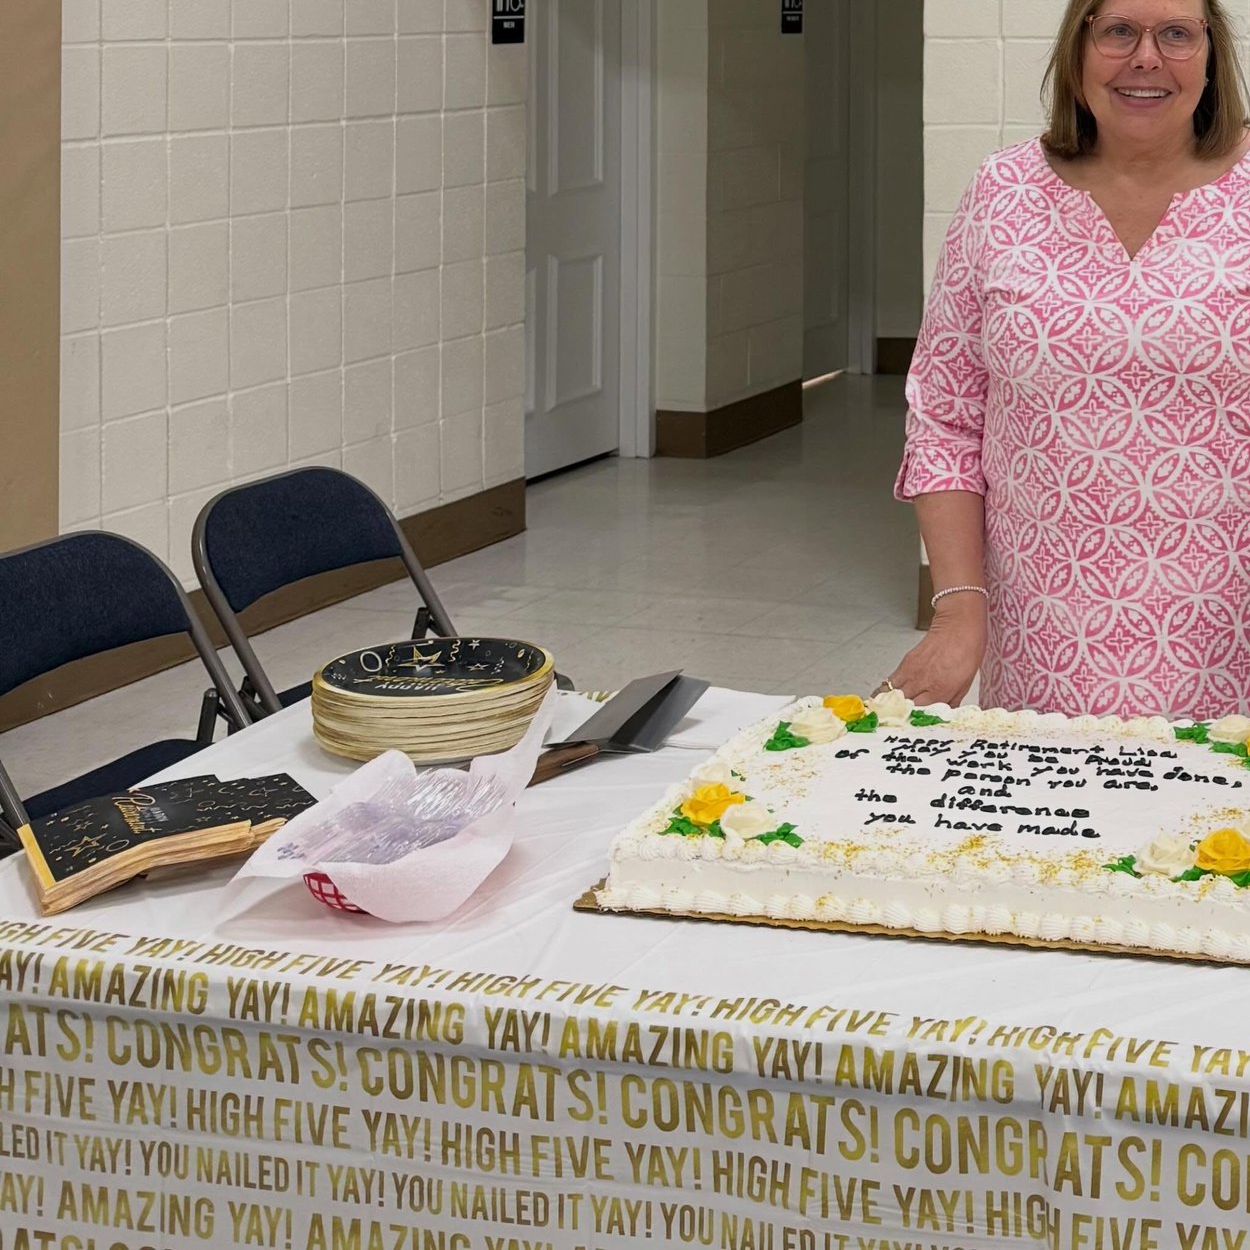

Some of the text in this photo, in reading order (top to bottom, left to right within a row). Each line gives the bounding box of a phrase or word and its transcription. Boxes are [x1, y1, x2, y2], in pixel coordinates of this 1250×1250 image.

[946, 758, 1012, 771] work
[1096, 766, 1154, 778] have
[970, 738, 1105, 755] Retirement
[1119, 746, 1177, 758] Lisa
[854, 788, 897, 803] the
[863, 812, 1101, 839] you have made
[957, 784, 1012, 798] and
[0, 949, 45, 993] AY!
[49, 957, 210, 1012] AMAZING
[226, 977, 291, 1020] YAY!
[299, 987, 466, 1043] AMAZING
[484, 1008, 550, 1051] YAY!
[558, 1017, 735, 1072] AMAZING
[752, 1036, 823, 1084] YAY!
[834, 1044, 1015, 1102] AMAZING
[1034, 1065, 1103, 1117] YAY!
[36, 927, 131, 953] FIVE
[123, 936, 204, 962] YAY!
[197, 941, 289, 970] HIGH
[287, 954, 375, 981] FIVE
[368, 962, 455, 990] YAY!
[445, 970, 542, 999] HIGH
[534, 980, 630, 1008] FIVE
[631, 989, 709, 1018] YAY!
[709, 997, 809, 1026] HIGH
[803, 1004, 899, 1037] FIVE
[906, 1015, 987, 1045] YAY!
[987, 1024, 1084, 1058] HIGH
[1083, 1027, 1180, 1069] FIVE
[107, 1019, 348, 1090] CONGRATS!
[357, 1049, 607, 1125] CONGRATS!
[620, 1076, 879, 1163] CONGRATS!
[893, 1109, 1162, 1201] CONGRATS!
[25, 1072, 95, 1120] FIVE
[109, 1082, 176, 1123] YAY!
[187, 1089, 264, 1137] HIGH
[274, 1099, 349, 1148] FIVE
[364, 1112, 431, 1158] YAY!
[441, 1124, 520, 1174] HIGH
[531, 1137, 613, 1180] FIVE
[627, 1144, 700, 1188] YAY!
[712, 1153, 790, 1208] HIGH
[799, 1168, 880, 1223] FIVE
[894, 1187, 973, 1230] YAY!
[985, 1192, 1060, 1250] HIGH
[1071, 1216, 1161, 1250] FIVE
[49, 1133, 66, 1160] IT
[75, 1136, 131, 1171] YAY!
[142, 1144, 189, 1179] YOU
[196, 1148, 289, 1190] NAILED
[297, 1163, 319, 1196] IT
[327, 1167, 384, 1200] YAY!
[394, 1177, 443, 1212] YOU
[451, 1184, 548, 1224] NAILED
[559, 1194, 582, 1228] IT
[591, 1197, 652, 1234] YAY!
[662, 1207, 714, 1244] YOU
[0, 1174, 44, 1212] AY!
[59, 1183, 214, 1238] AMAZING
[229, 1203, 291, 1250] YAY!
